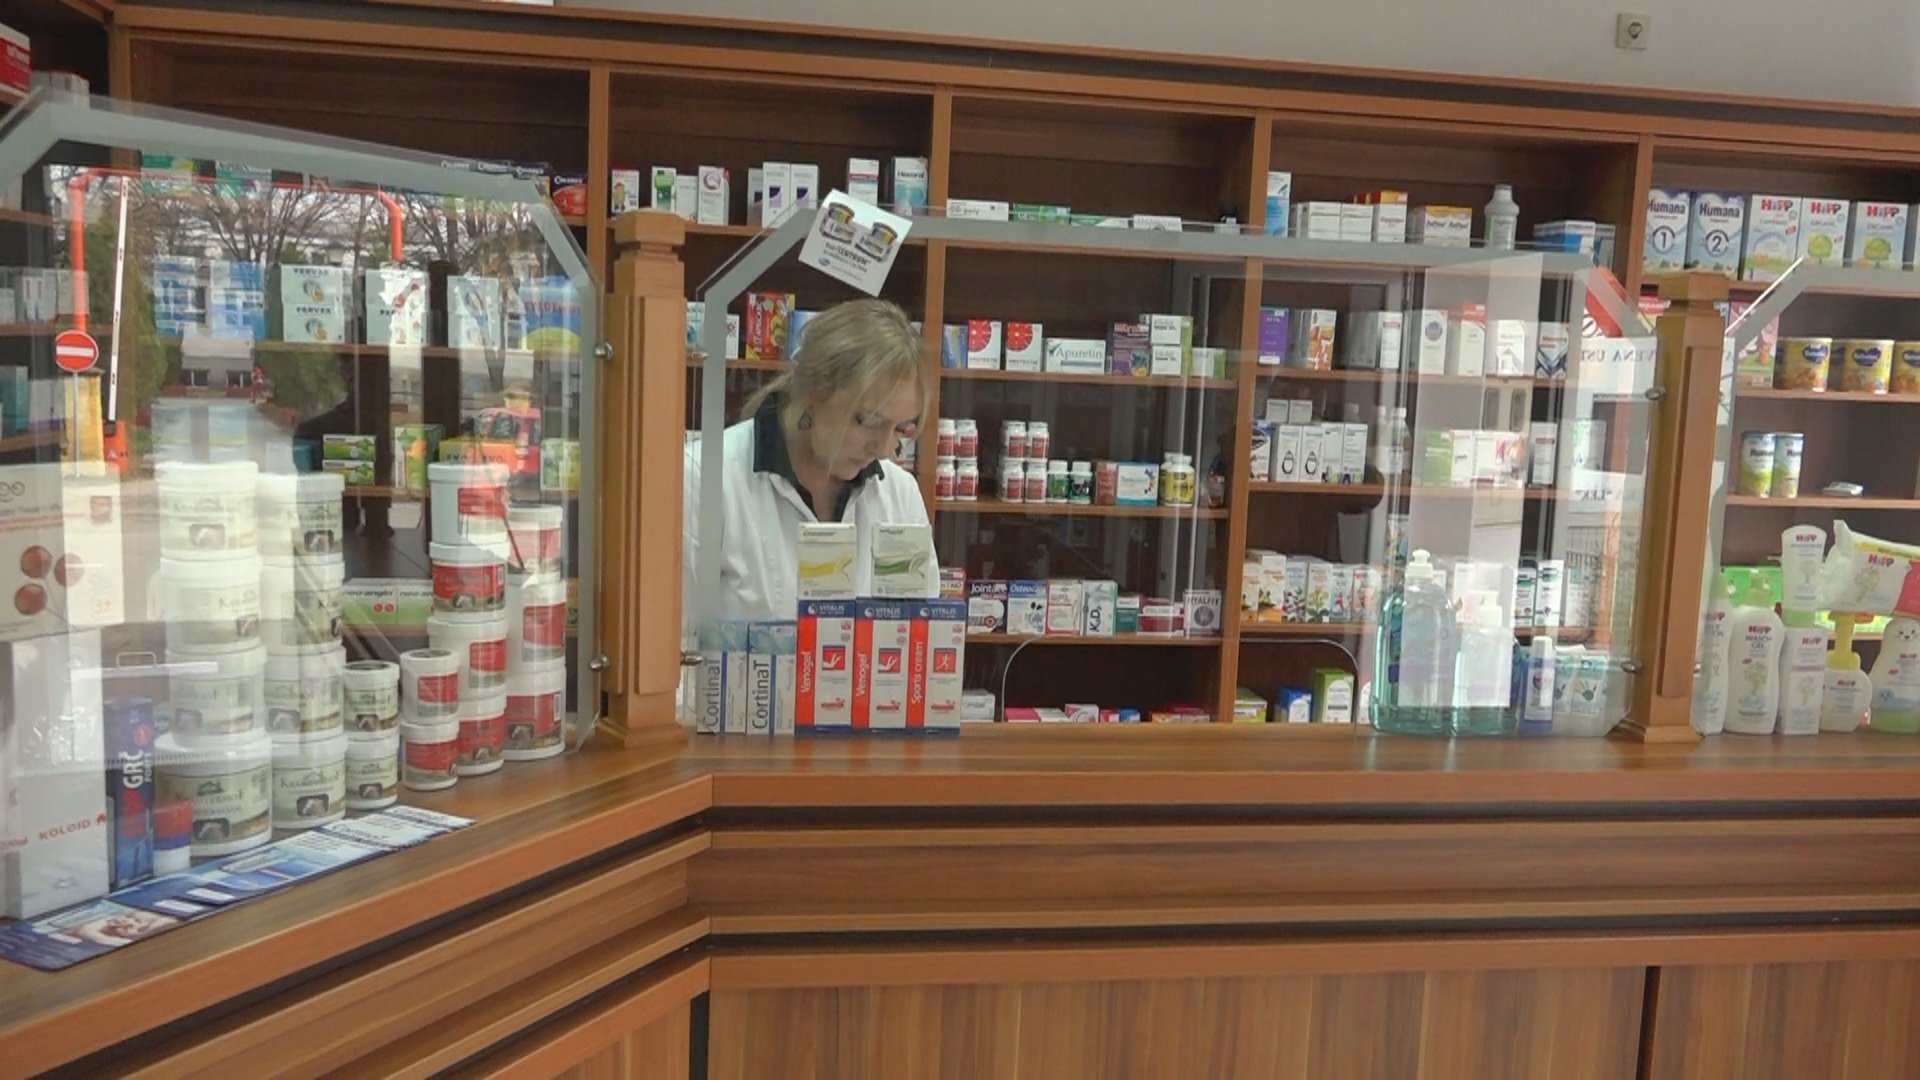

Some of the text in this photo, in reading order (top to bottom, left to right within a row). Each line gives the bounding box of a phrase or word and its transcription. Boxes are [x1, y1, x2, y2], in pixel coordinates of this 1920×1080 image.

[1647, 199, 1687, 216] Humana
[1699, 201, 1741, 219] Humana
[1761, 198, 1794, 212] HiPP
[1810, 201, 1842, 215] HiPP
[1866, 205, 1900, 218] HiPP
[1711, 235, 1723, 253] 2
[1054, 345, 1104, 361] Apuretin
[819, 604, 845, 612] VITALIS
[875, 607, 901, 615] VITALIS
[930, 607, 957, 615] VITALIS
[801, 651, 814, 694] Venogel
[856, 653, 868, 698] Venogel
[751, 659, 770, 730] CortinaT
[38, 818, 92, 842] KOLOID
